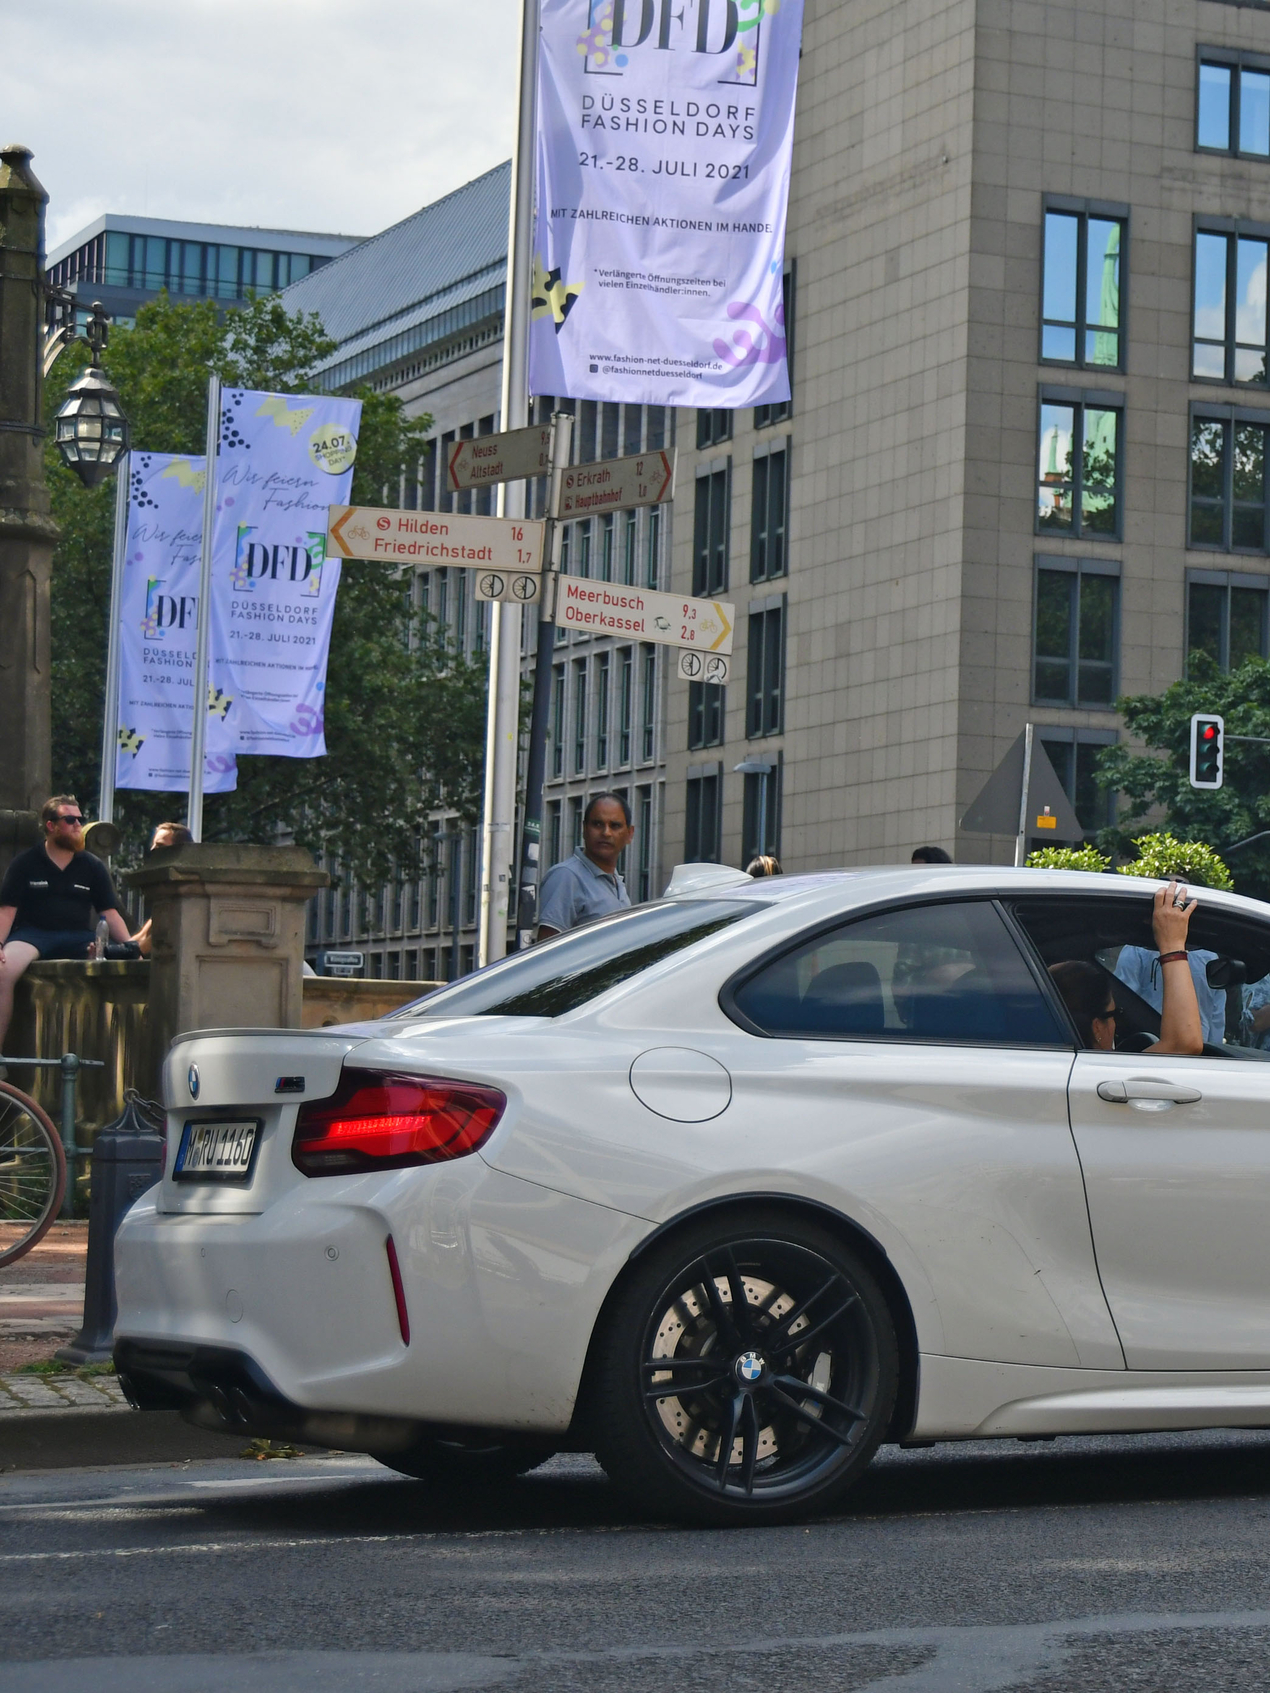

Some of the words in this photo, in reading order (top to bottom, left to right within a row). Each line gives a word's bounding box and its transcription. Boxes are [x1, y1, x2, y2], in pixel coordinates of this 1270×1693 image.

[607, 0, 739, 54] DFD
[582, 93, 756, 122] DÜSSELDORF
[581, 114, 686, 136] FASHION
[696, 121, 755, 141] DAYS
[579, 152, 645, 174] 21.-28.
[652, 159, 697, 178] JULI
[705, 162, 750, 180] 2021
[550, 208, 567, 219] MIT
[571, 208, 650, 226] ZAHLREICHEN
[653, 217, 713, 232] AKTIONEN
[716, 222, 729, 233] IM
[598, 280, 624, 289] vielen
[647, 272, 711, 287] Öffnungszeiten
[713, 278, 726, 288] bei
[589, 353, 723, 371] www.fashion-net-duesseldorf.de
[313, 435, 350, 454] 24.07.
[472, 444, 498, 459] Neuss
[222, 465, 262, 486] Wir
[262, 471, 319, 490] feiern
[470, 461, 503, 479] Altstadt
[577, 468, 611, 487] Erkrath
[636, 461, 644, 476] 12
[575, 487, 623, 509] Hauptbahnhof
[131, 523, 170, 543] Wir
[398, 517, 449, 536] Hilden
[511, 526, 524, 541] 16
[374, 537, 492, 560] Friedrichstadt
[247, 542, 313, 583] DFD
[231, 600, 319, 615] DÜSSELDORF
[567, 584, 645, 611] Meerbusch
[230, 610, 285, 623] FASHION
[288, 613, 318, 626] DAYS
[565, 605, 645, 633] Oberkassel
[229, 630, 265, 642] 21.-28.
[267, 633, 291, 643] JULI
[292, 635, 317, 646] 2021
[143, 657, 194, 669] FASHION
